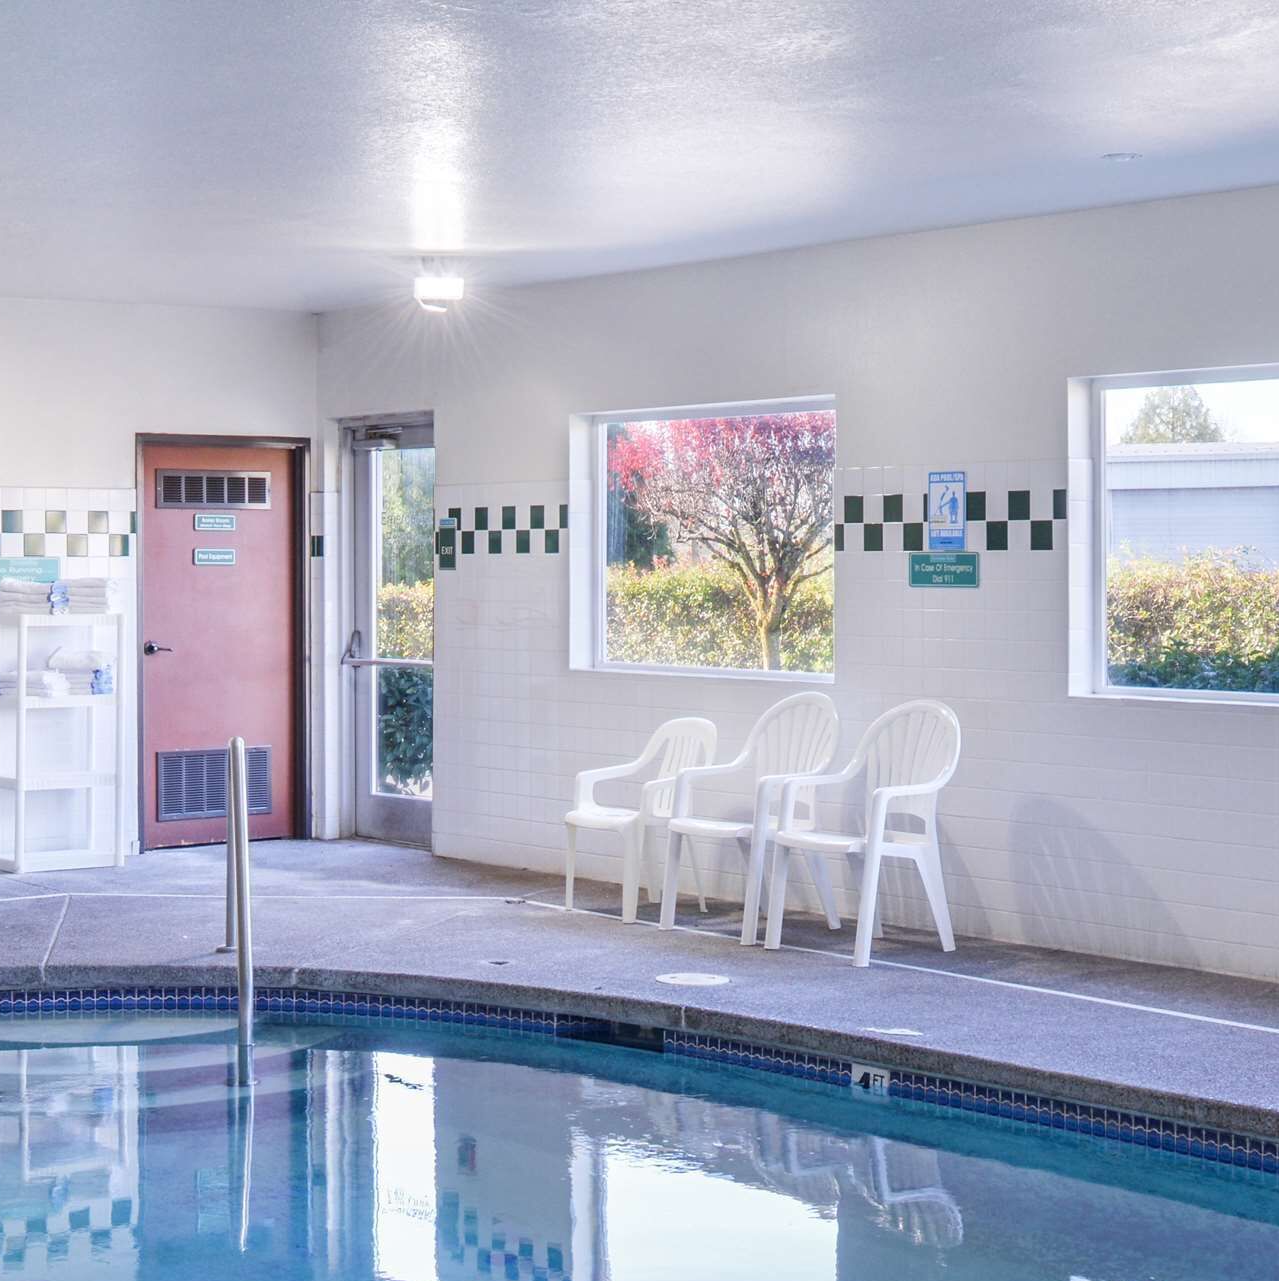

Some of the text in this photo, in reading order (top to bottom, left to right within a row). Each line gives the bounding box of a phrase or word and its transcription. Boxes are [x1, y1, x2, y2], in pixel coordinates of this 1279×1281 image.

[442, 546, 453, 555] EXIT
[921, 564, 935, 572] Case
[936, 564, 943, 572] Of
[944, 564, 973, 574] Emergency
[932, 575, 954, 583] Dial 911
[857, 1072, 885, 1089] 4 FT
